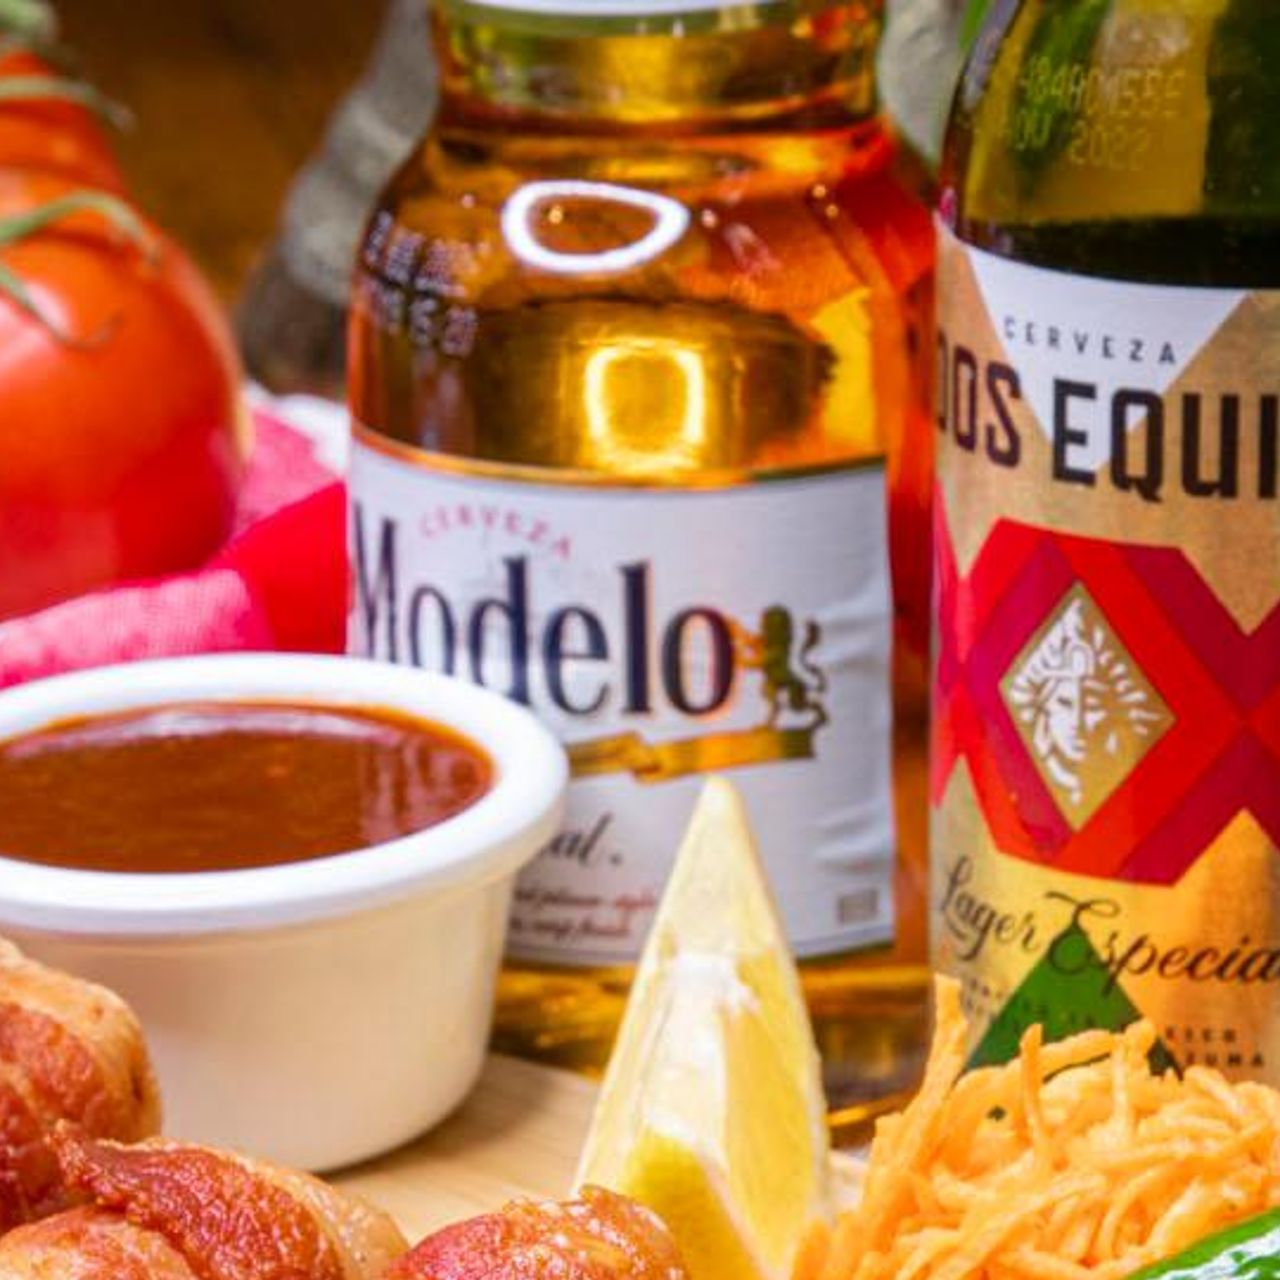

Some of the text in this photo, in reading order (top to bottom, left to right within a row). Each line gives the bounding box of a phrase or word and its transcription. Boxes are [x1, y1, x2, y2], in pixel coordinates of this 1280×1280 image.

[1003, 315, 1177, 365] CERVEZA
[420, 504, 572, 559] CERVEZA
[353, 500, 735, 717] Modelo
[940, 854, 1043, 963] Lager
